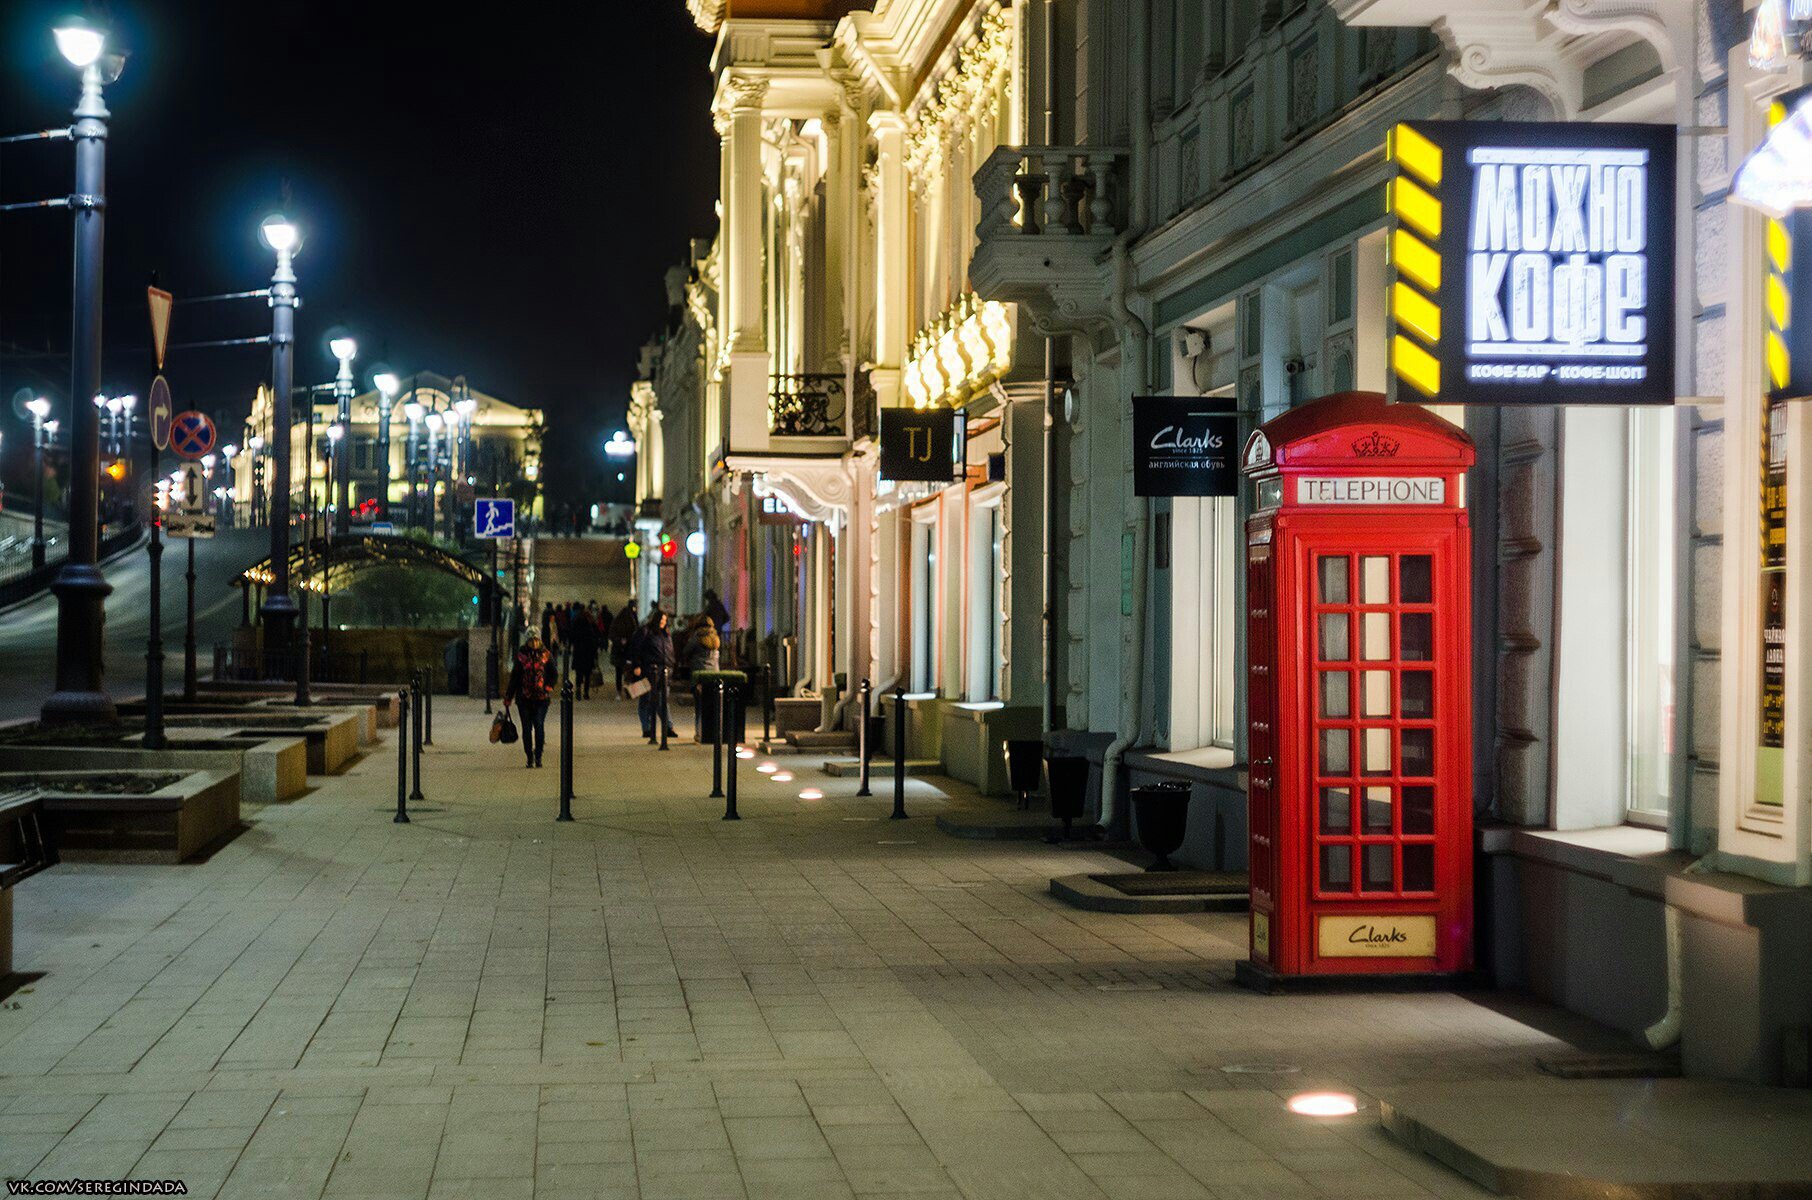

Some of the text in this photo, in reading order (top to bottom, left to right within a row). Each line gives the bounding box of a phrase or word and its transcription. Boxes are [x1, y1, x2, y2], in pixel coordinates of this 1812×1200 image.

[1473, 163, 1645, 252] МОЖНО
[1471, 364, 1644, 380] КОФЕ-БАР КОФЕ-ШОП
[902, 427, 932, 462] TJ
[1150, 425, 1223, 449] Clarks
[1149, 459, 1225, 470] английская обувь
[1304, 480, 1440, 501] TELEPHONE
[1348, 925, 1407, 943] Clarks
